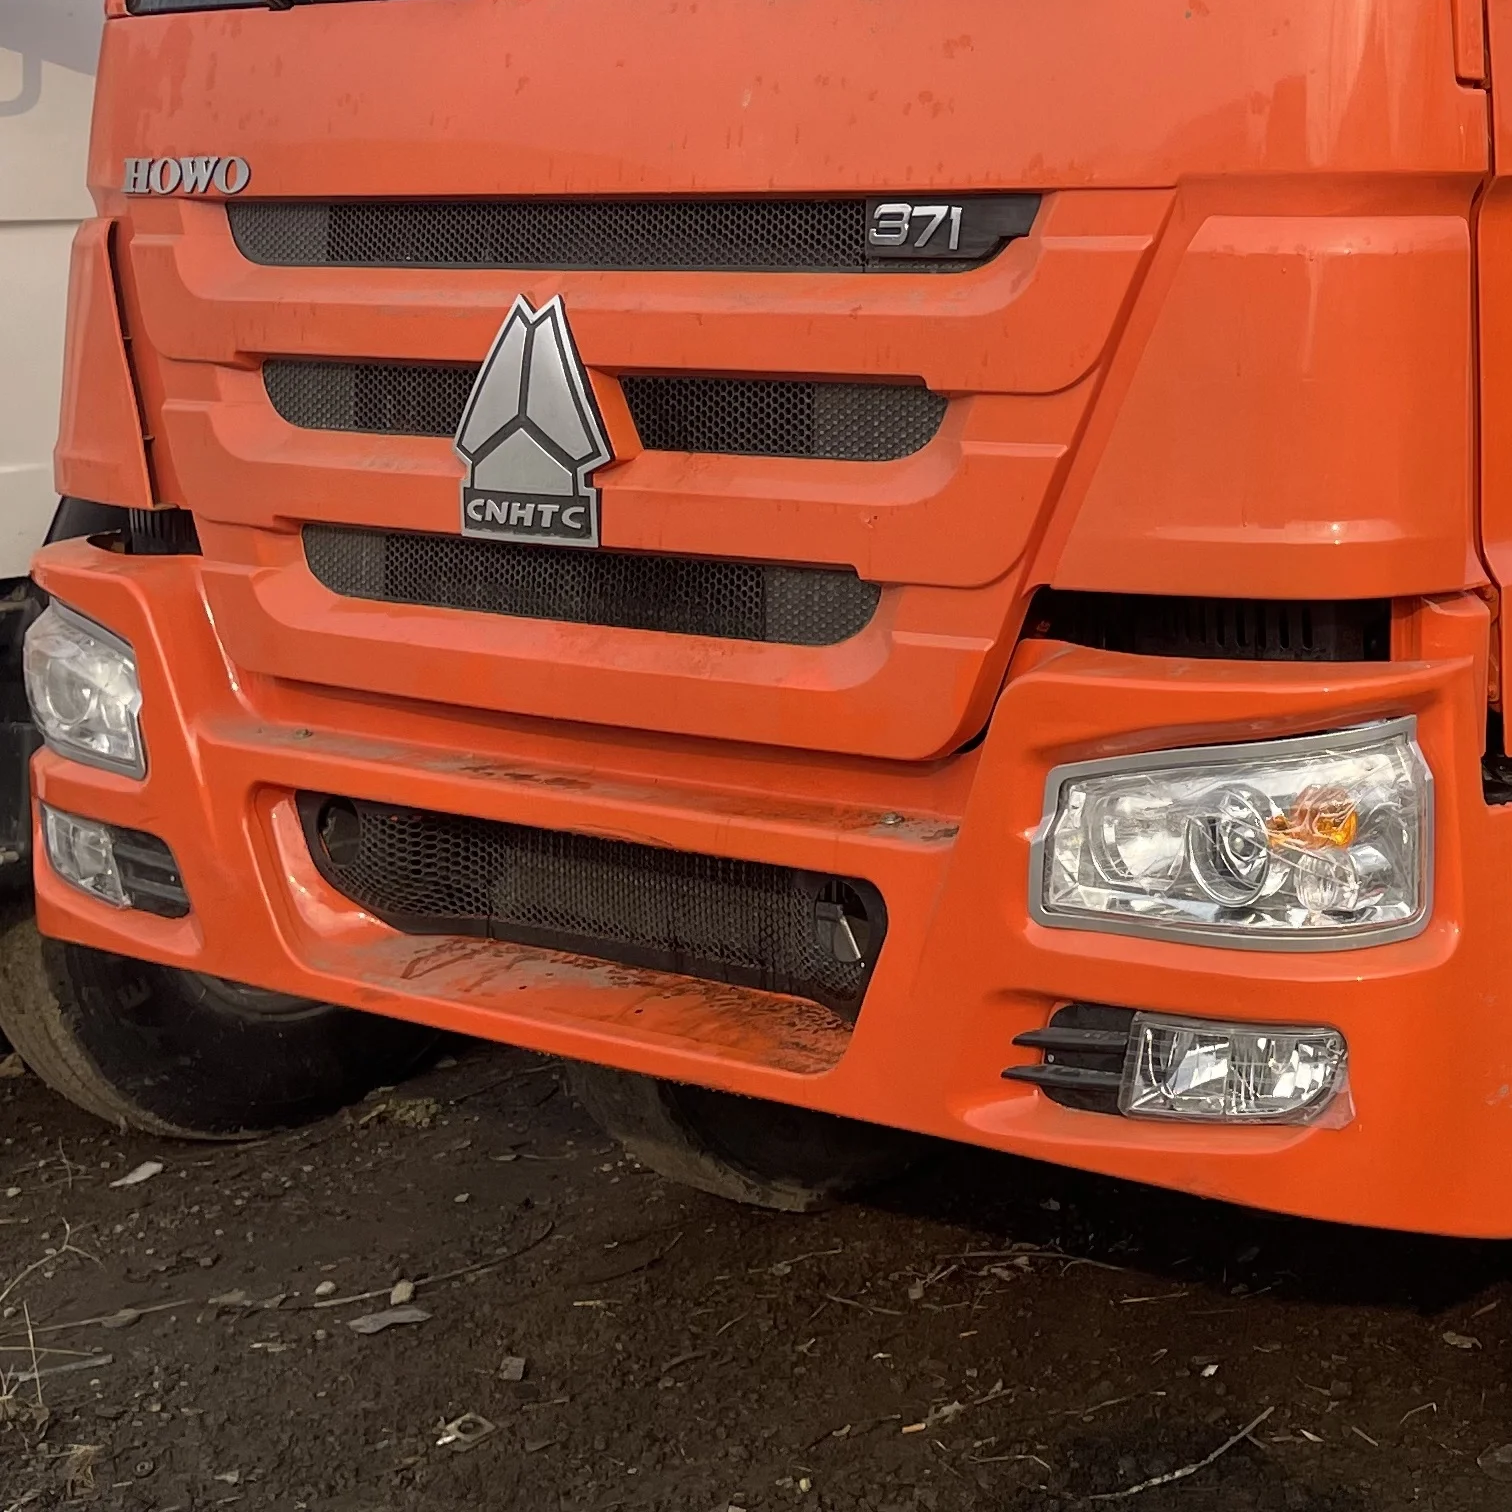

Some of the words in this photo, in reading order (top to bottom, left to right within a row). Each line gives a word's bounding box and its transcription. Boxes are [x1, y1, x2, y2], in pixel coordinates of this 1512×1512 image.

[121, 157, 251, 195] HOWO
[868, 202, 963, 251] 371
[466, 498, 586, 529] CNHTC
